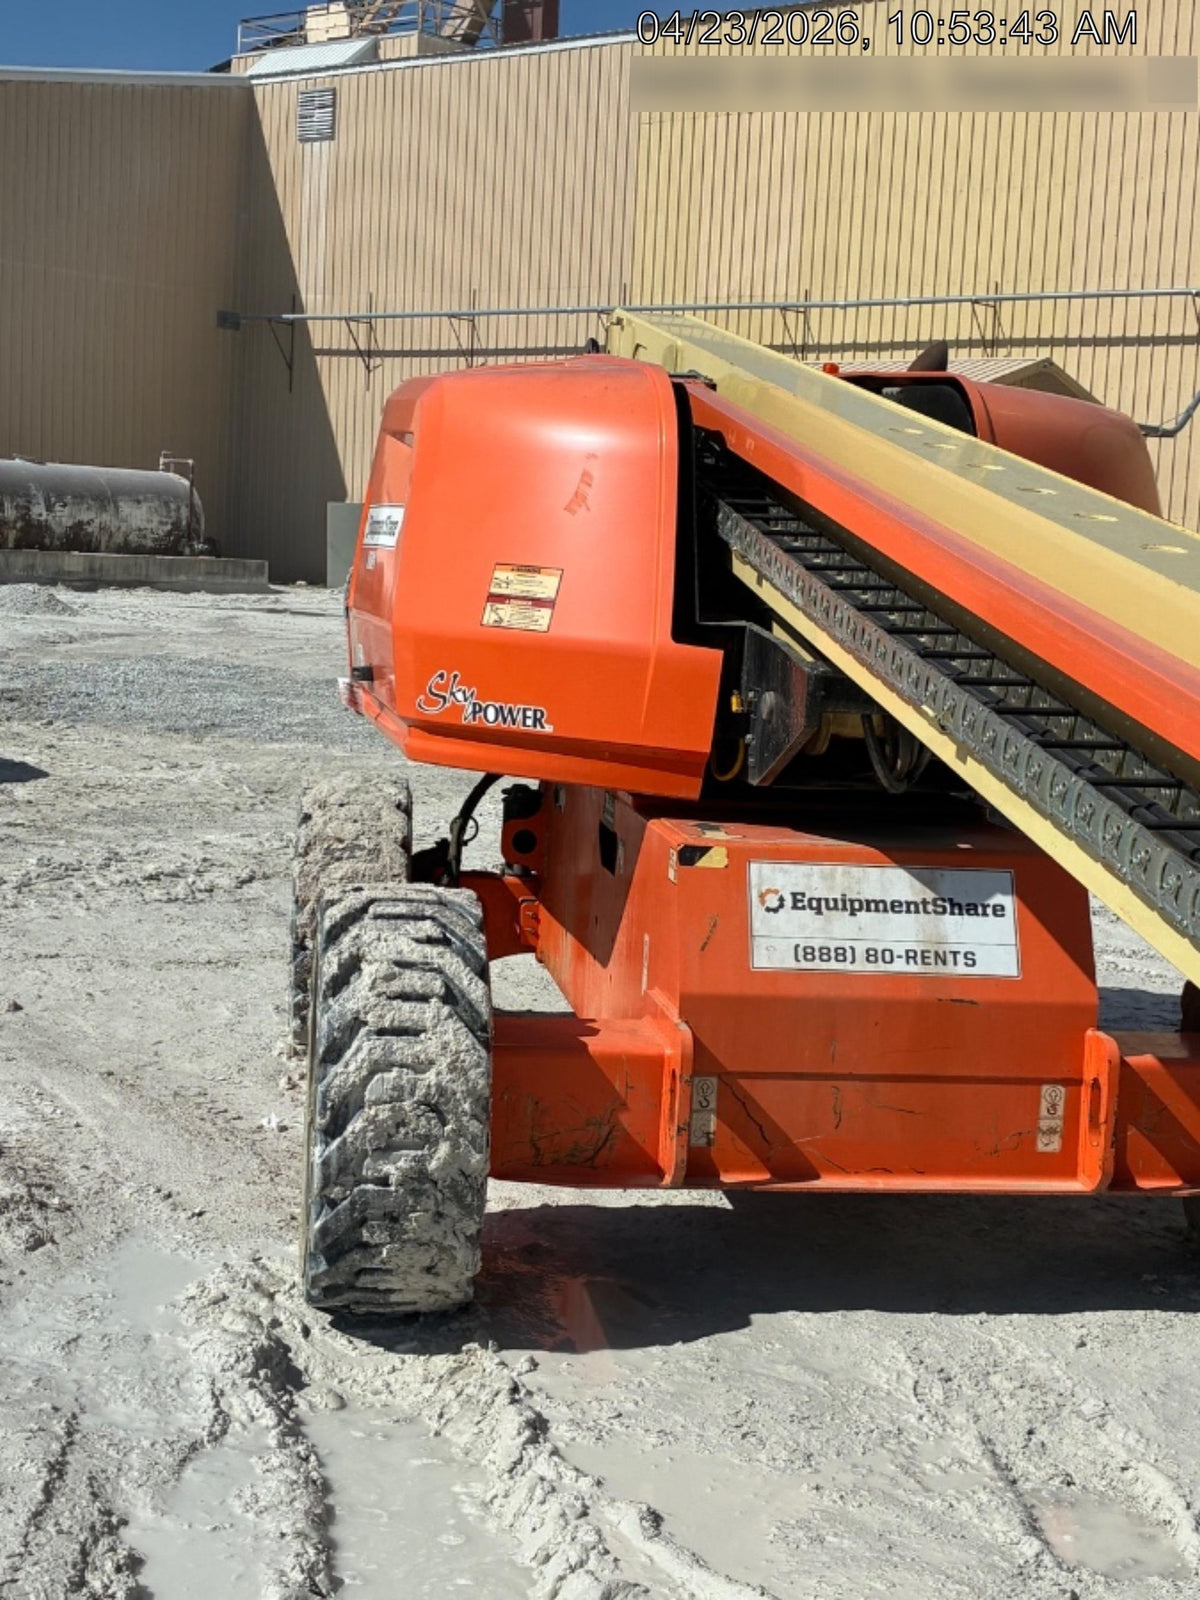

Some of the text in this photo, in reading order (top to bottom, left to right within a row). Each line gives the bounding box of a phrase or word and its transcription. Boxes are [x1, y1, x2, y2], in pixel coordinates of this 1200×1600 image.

[790, 891, 1007, 918] EquipmentShare
[793, 943, 978, 968] (888) 80-RENTS
